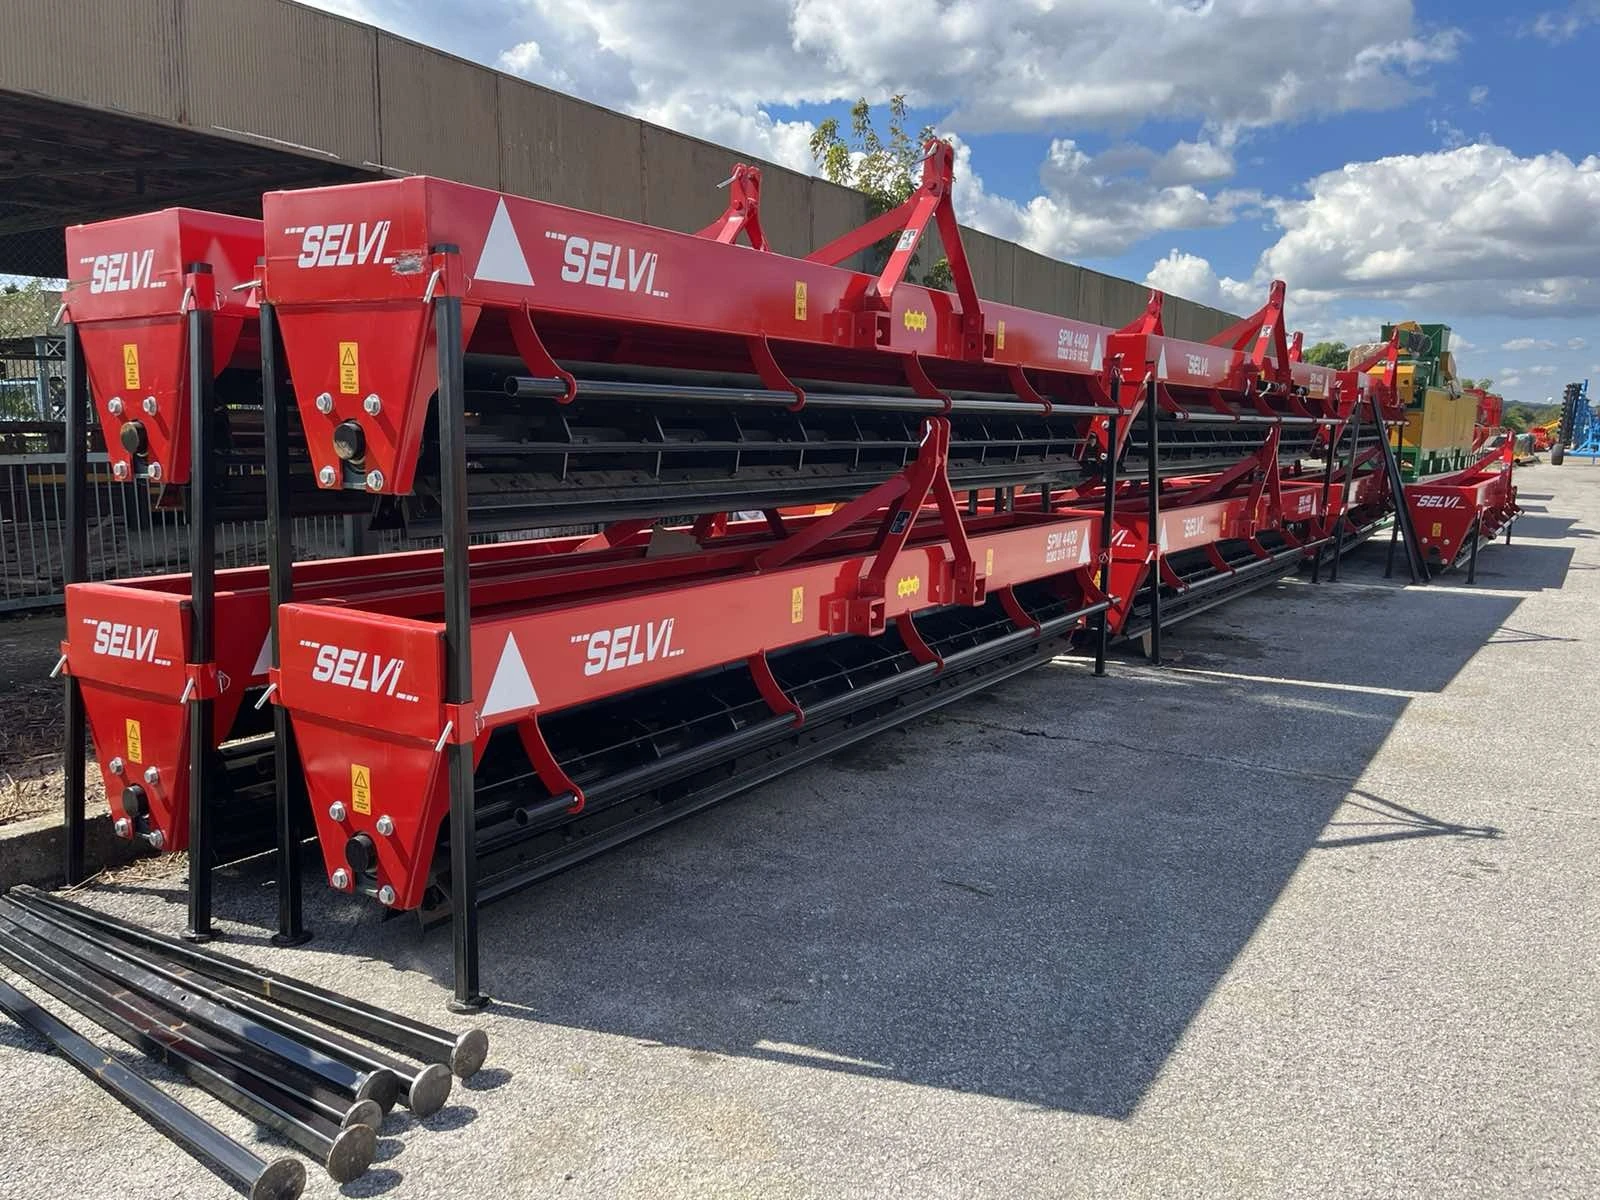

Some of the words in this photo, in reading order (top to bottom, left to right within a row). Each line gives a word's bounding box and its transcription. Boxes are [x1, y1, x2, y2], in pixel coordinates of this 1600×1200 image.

[298, 220, 391, 269] SELVI
[561, 236, 658, 296] SELVI
[90, 248, 155, 294] SELVI
[1417, 495, 1460, 508] SELVI
[93, 620, 158, 664] SELVI
[584, 618, 675, 677] SELVI
[313, 643, 405, 696] SELVI
